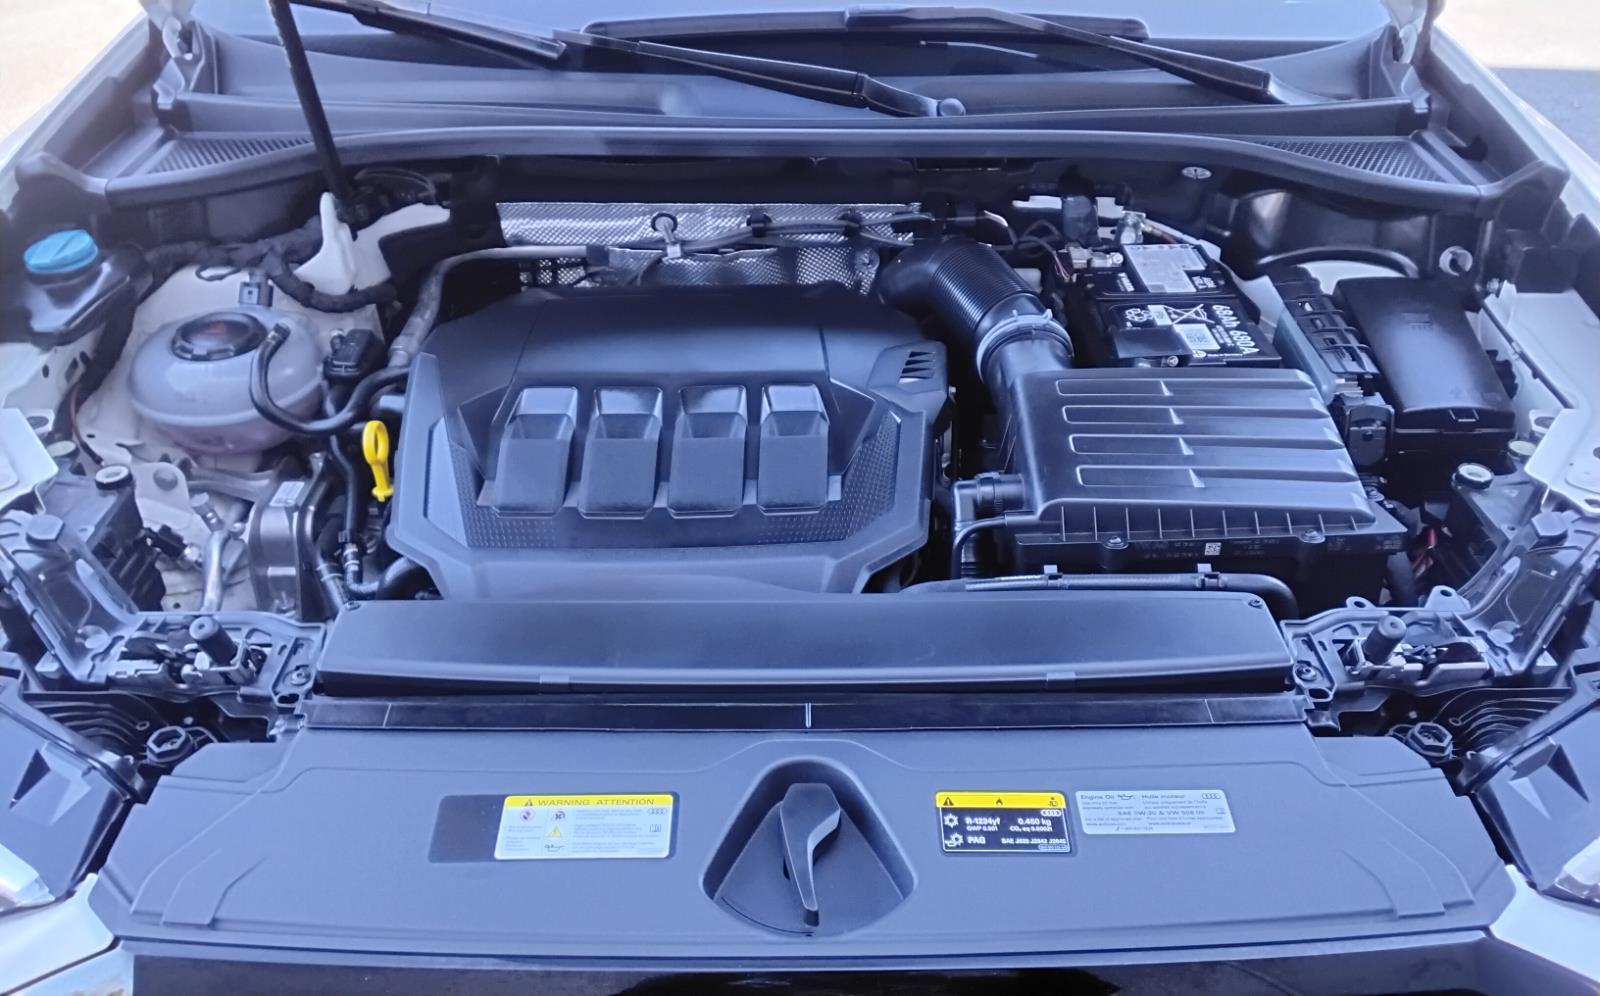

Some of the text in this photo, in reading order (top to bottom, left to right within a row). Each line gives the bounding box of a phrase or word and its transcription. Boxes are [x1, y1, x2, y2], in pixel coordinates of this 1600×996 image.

[1212, 304, 1241, 328] 68Ah
[1229, 330, 1260, 355] 680A
[596, 798, 655, 806] ATTENTION
[1041, 817, 1052, 826] kg
[966, 836, 986, 844] PAG
